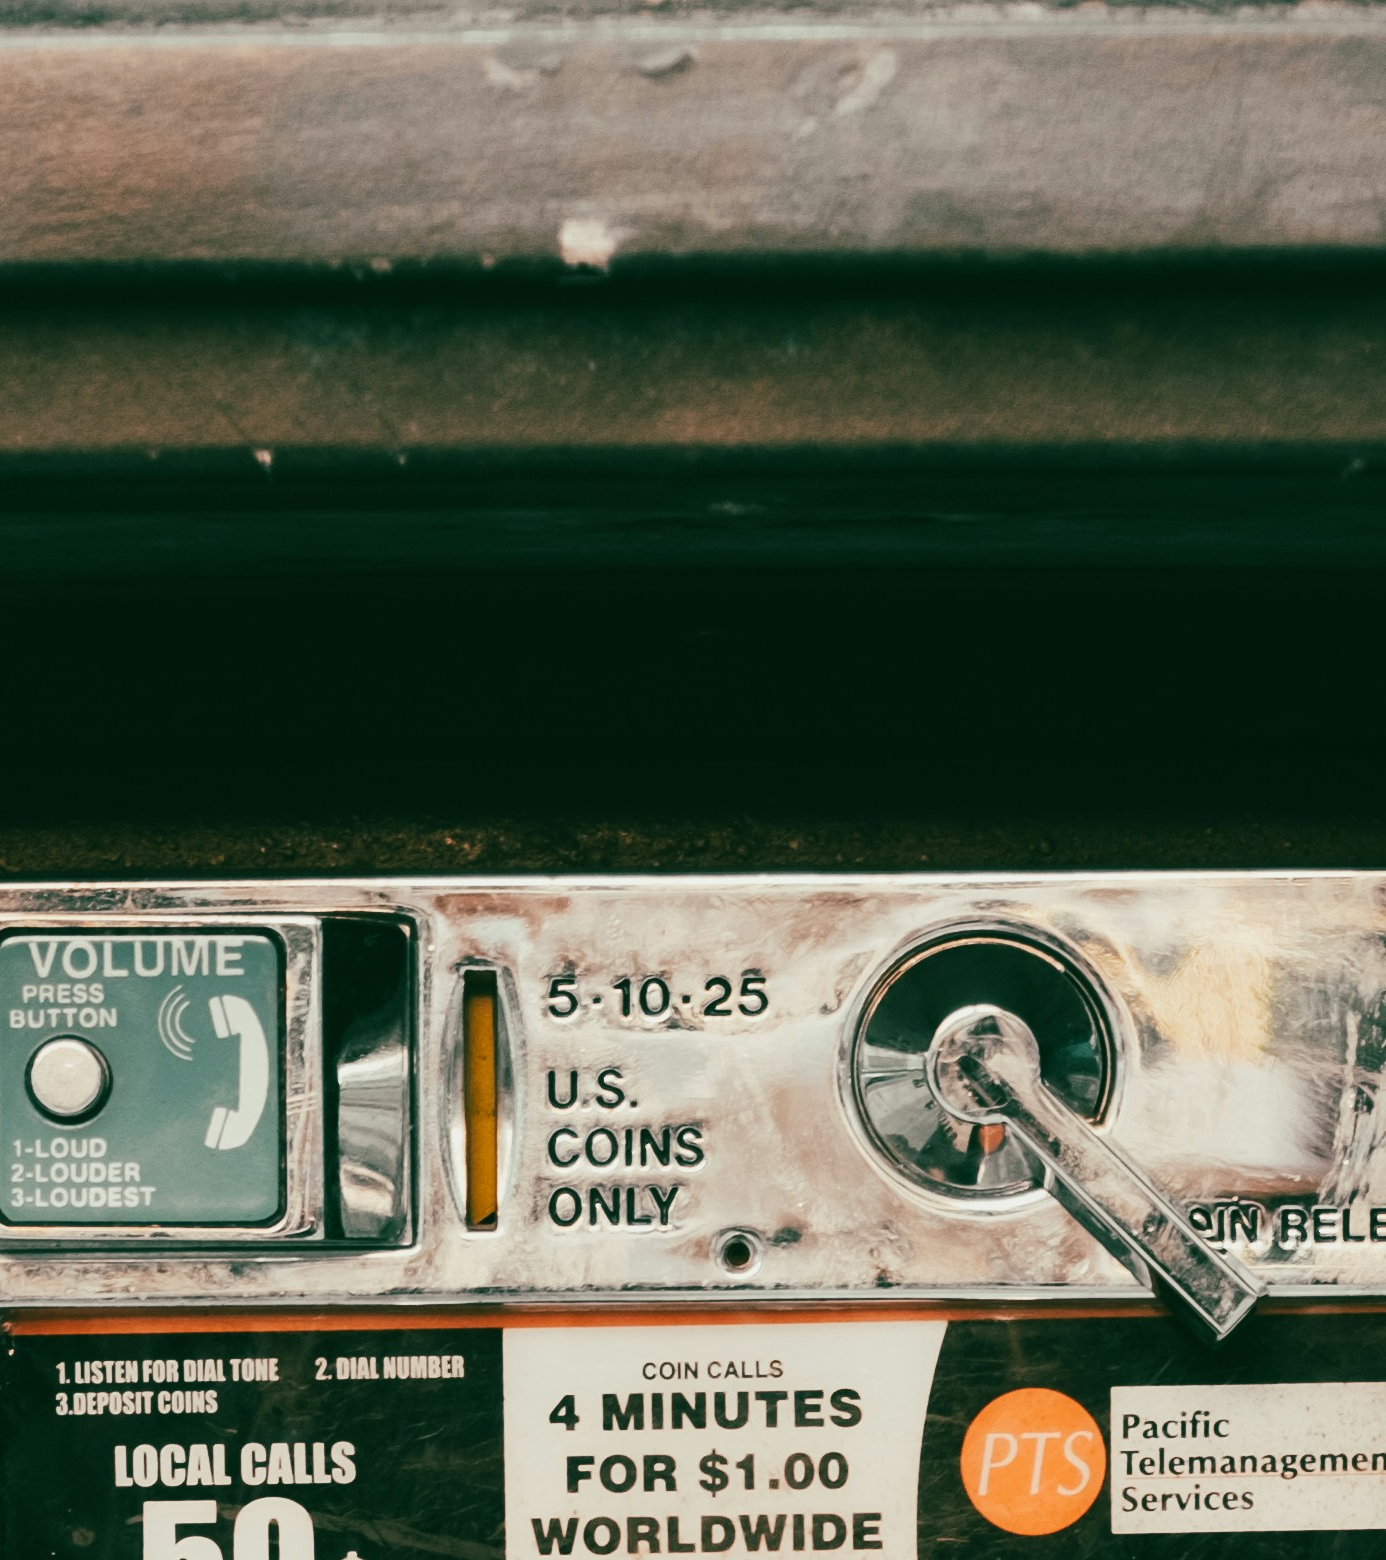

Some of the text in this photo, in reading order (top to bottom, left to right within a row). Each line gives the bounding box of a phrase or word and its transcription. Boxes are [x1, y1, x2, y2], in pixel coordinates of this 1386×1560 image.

[30, 940, 244, 979] VOLUME
[22, 984, 104, 1004] PRESS
[10, 1008, 117, 1029] BUTTON
[547, 1068, 638, 1109] U.S.
[14, 1139, 106, 1158] 1-LOUD
[547, 1126, 705, 1168] COINS
[11, 1163, 141, 1183] 2-LOUDER
[11, 1187, 155, 1208] 3-LOUDEST
[548, 1186, 680, 1227] ONLY
[1189, 1206, 1258, 1243] OIN
[56, 1358, 279, 1384] 1. LISTEN FOR DIAL TONE
[315, 1356, 465, 1380] 2. DIAL NUMBER
[642, 1360, 784, 1381] COIN CALLS
[157, 1390, 218, 1414] COINS
[549, 1388, 862, 1431] 4 MINUTES
[1122, 1411, 1230, 1440] Pacific
[114, 1441, 357, 1487] LOCAL CALLS
[566, 1448, 849, 1498] FOR $1.00
[978, 1430, 1093, 1497] PTS
[1122, 1484, 1254, 1512] Services
[531, 1512, 883, 1556] WORLDWIDE
